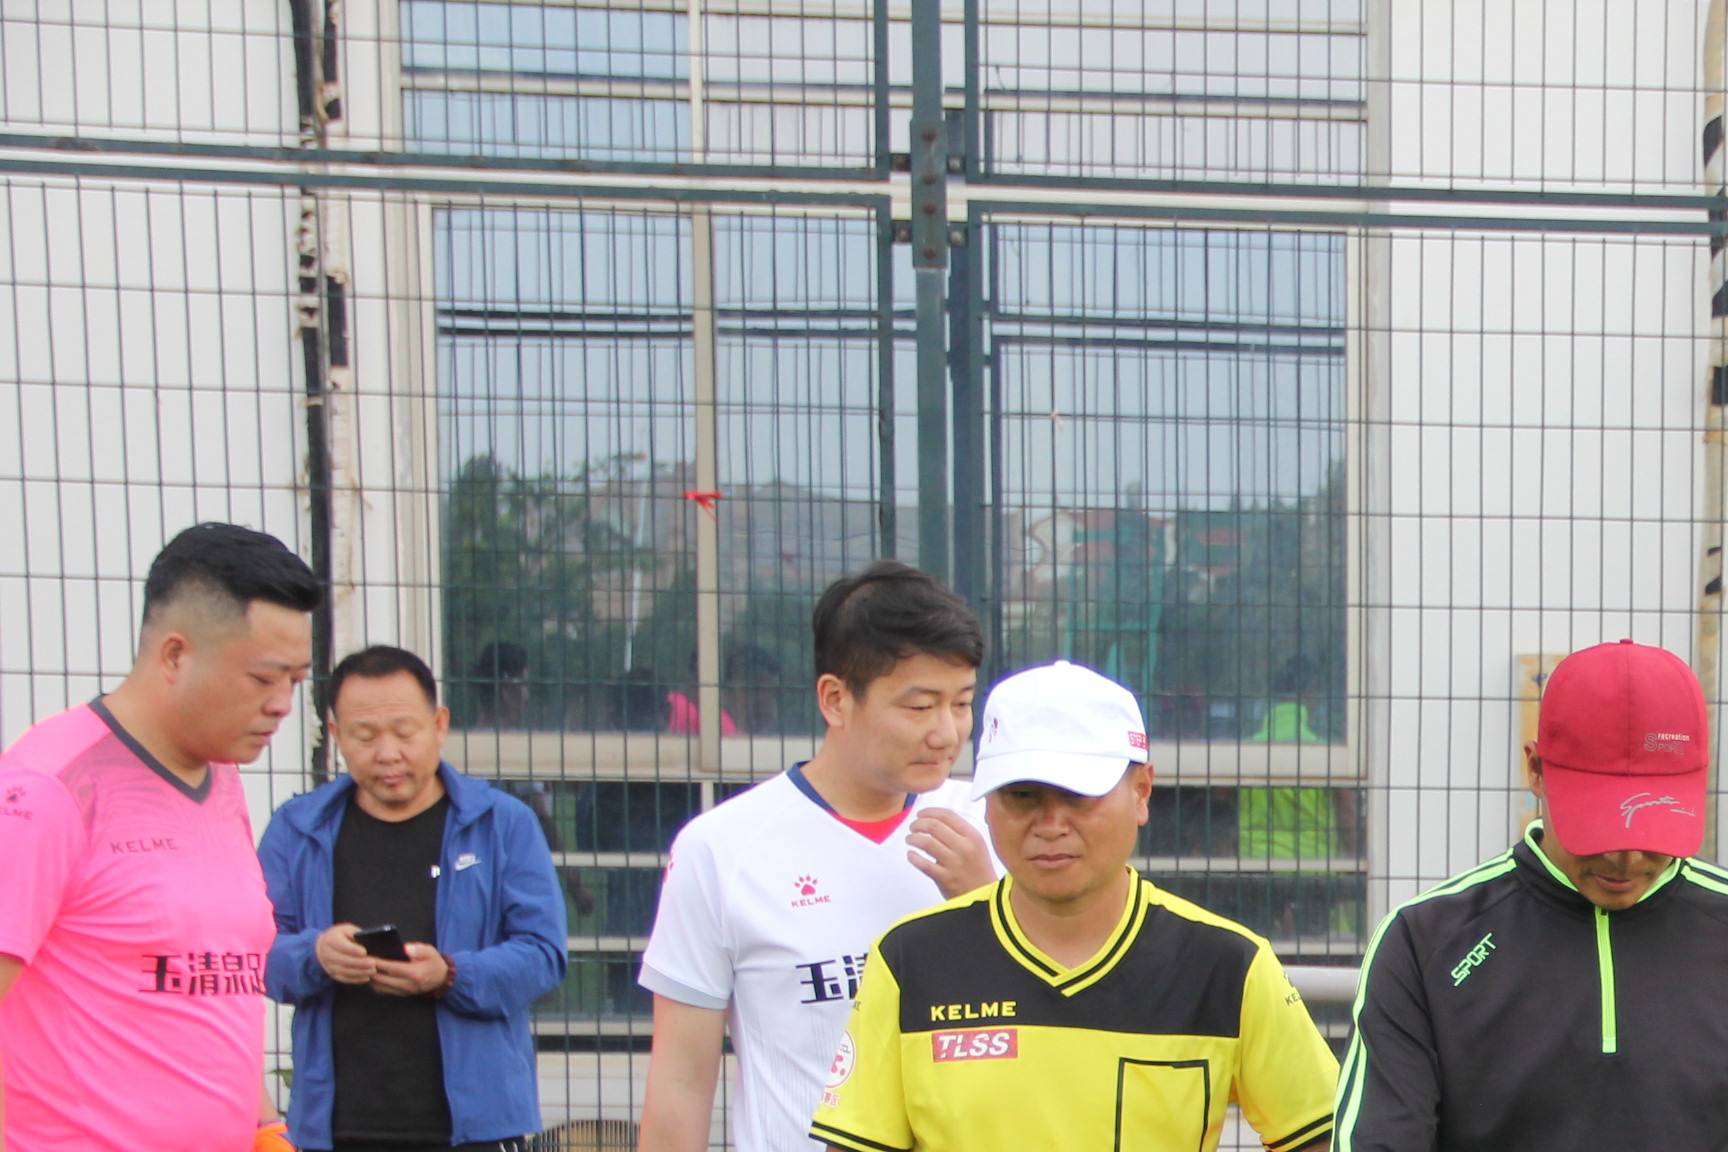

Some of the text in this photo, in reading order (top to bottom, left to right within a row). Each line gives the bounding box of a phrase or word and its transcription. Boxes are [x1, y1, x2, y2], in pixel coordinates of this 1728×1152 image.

[110, 838, 177, 854] KELME
[791, 895, 832, 908] KELME
[1450, 932, 1497, 988] SPORT
[930, 1001, 1016, 1022] KELME
[938, 1033, 1010, 1059] TLSS
